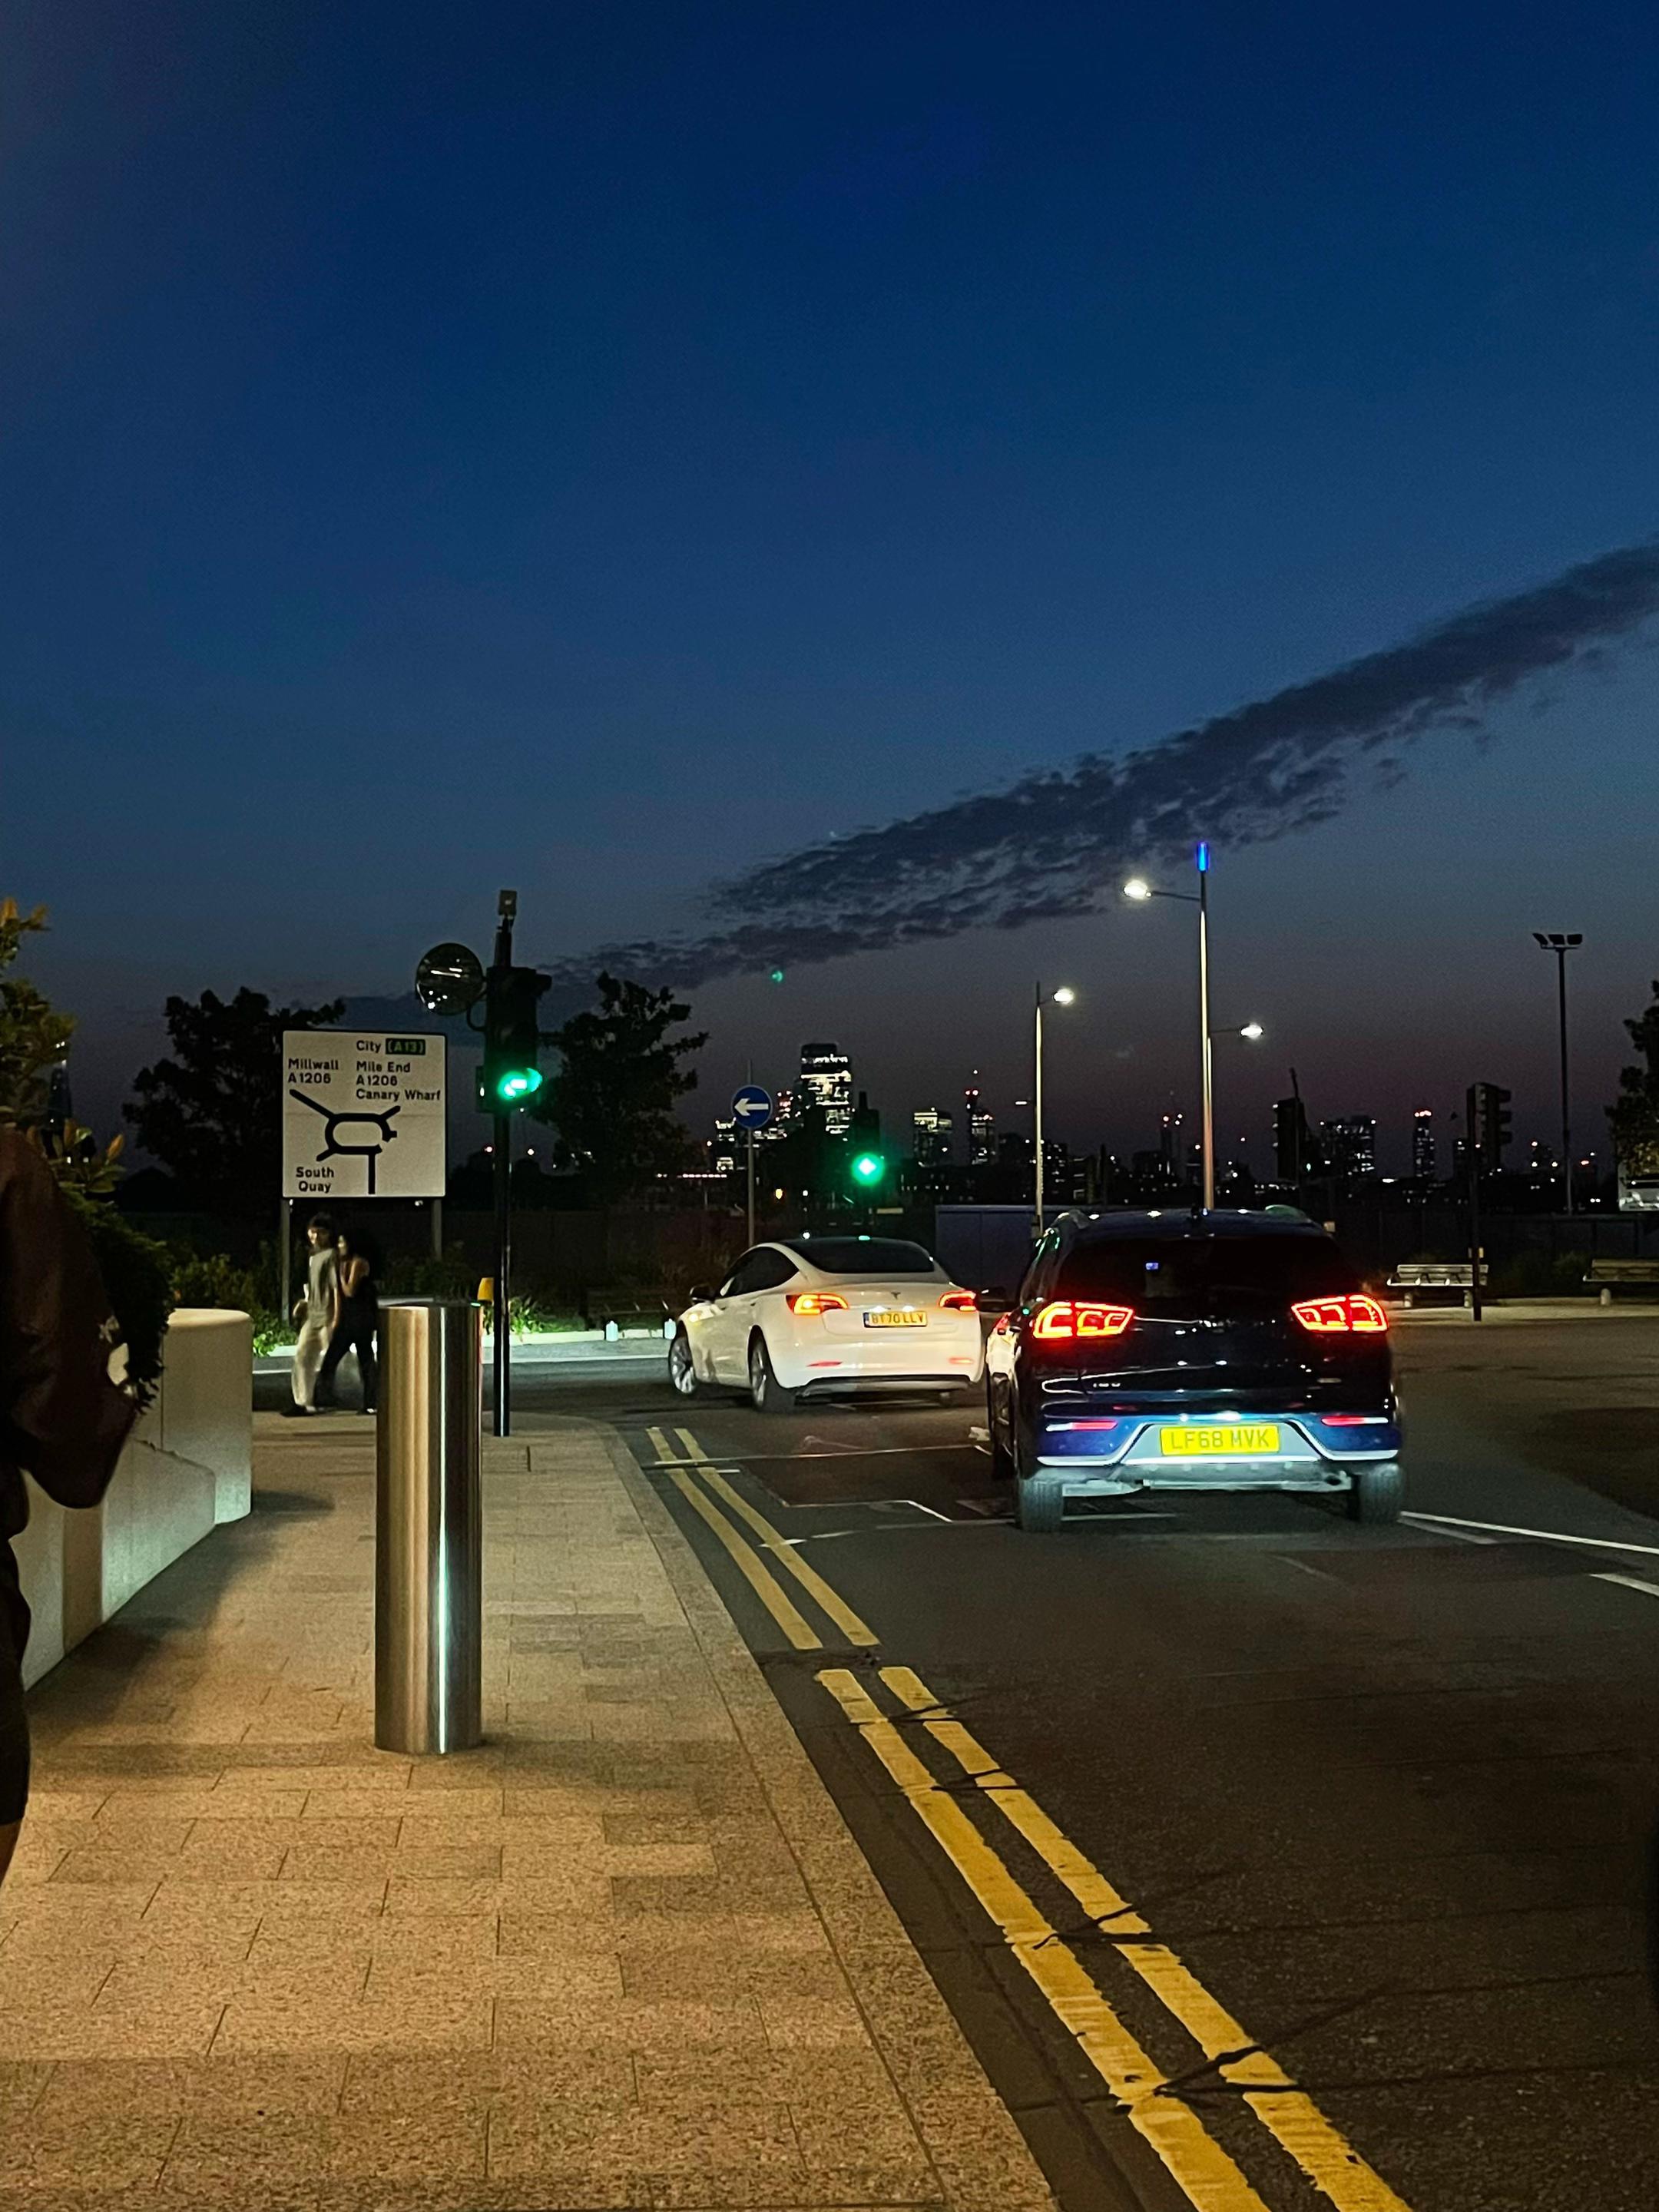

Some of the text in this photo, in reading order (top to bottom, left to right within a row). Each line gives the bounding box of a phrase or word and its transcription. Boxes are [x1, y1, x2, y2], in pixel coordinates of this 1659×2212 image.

[356, 1040, 382, 1054] City
[288, 1058, 339, 1071] Millwall
[356, 1061, 411, 1073] Mile End
[287, 1072, 332, 1084] A1206
[356, 1075, 398, 1086] A1206
[356, 1088, 441, 1101] Canary Wharf
[296, 1166, 335, 1178] South
[298, 1181, 332, 1194] Quay
[1171, 1429, 1270, 1450] LF68 MVK
